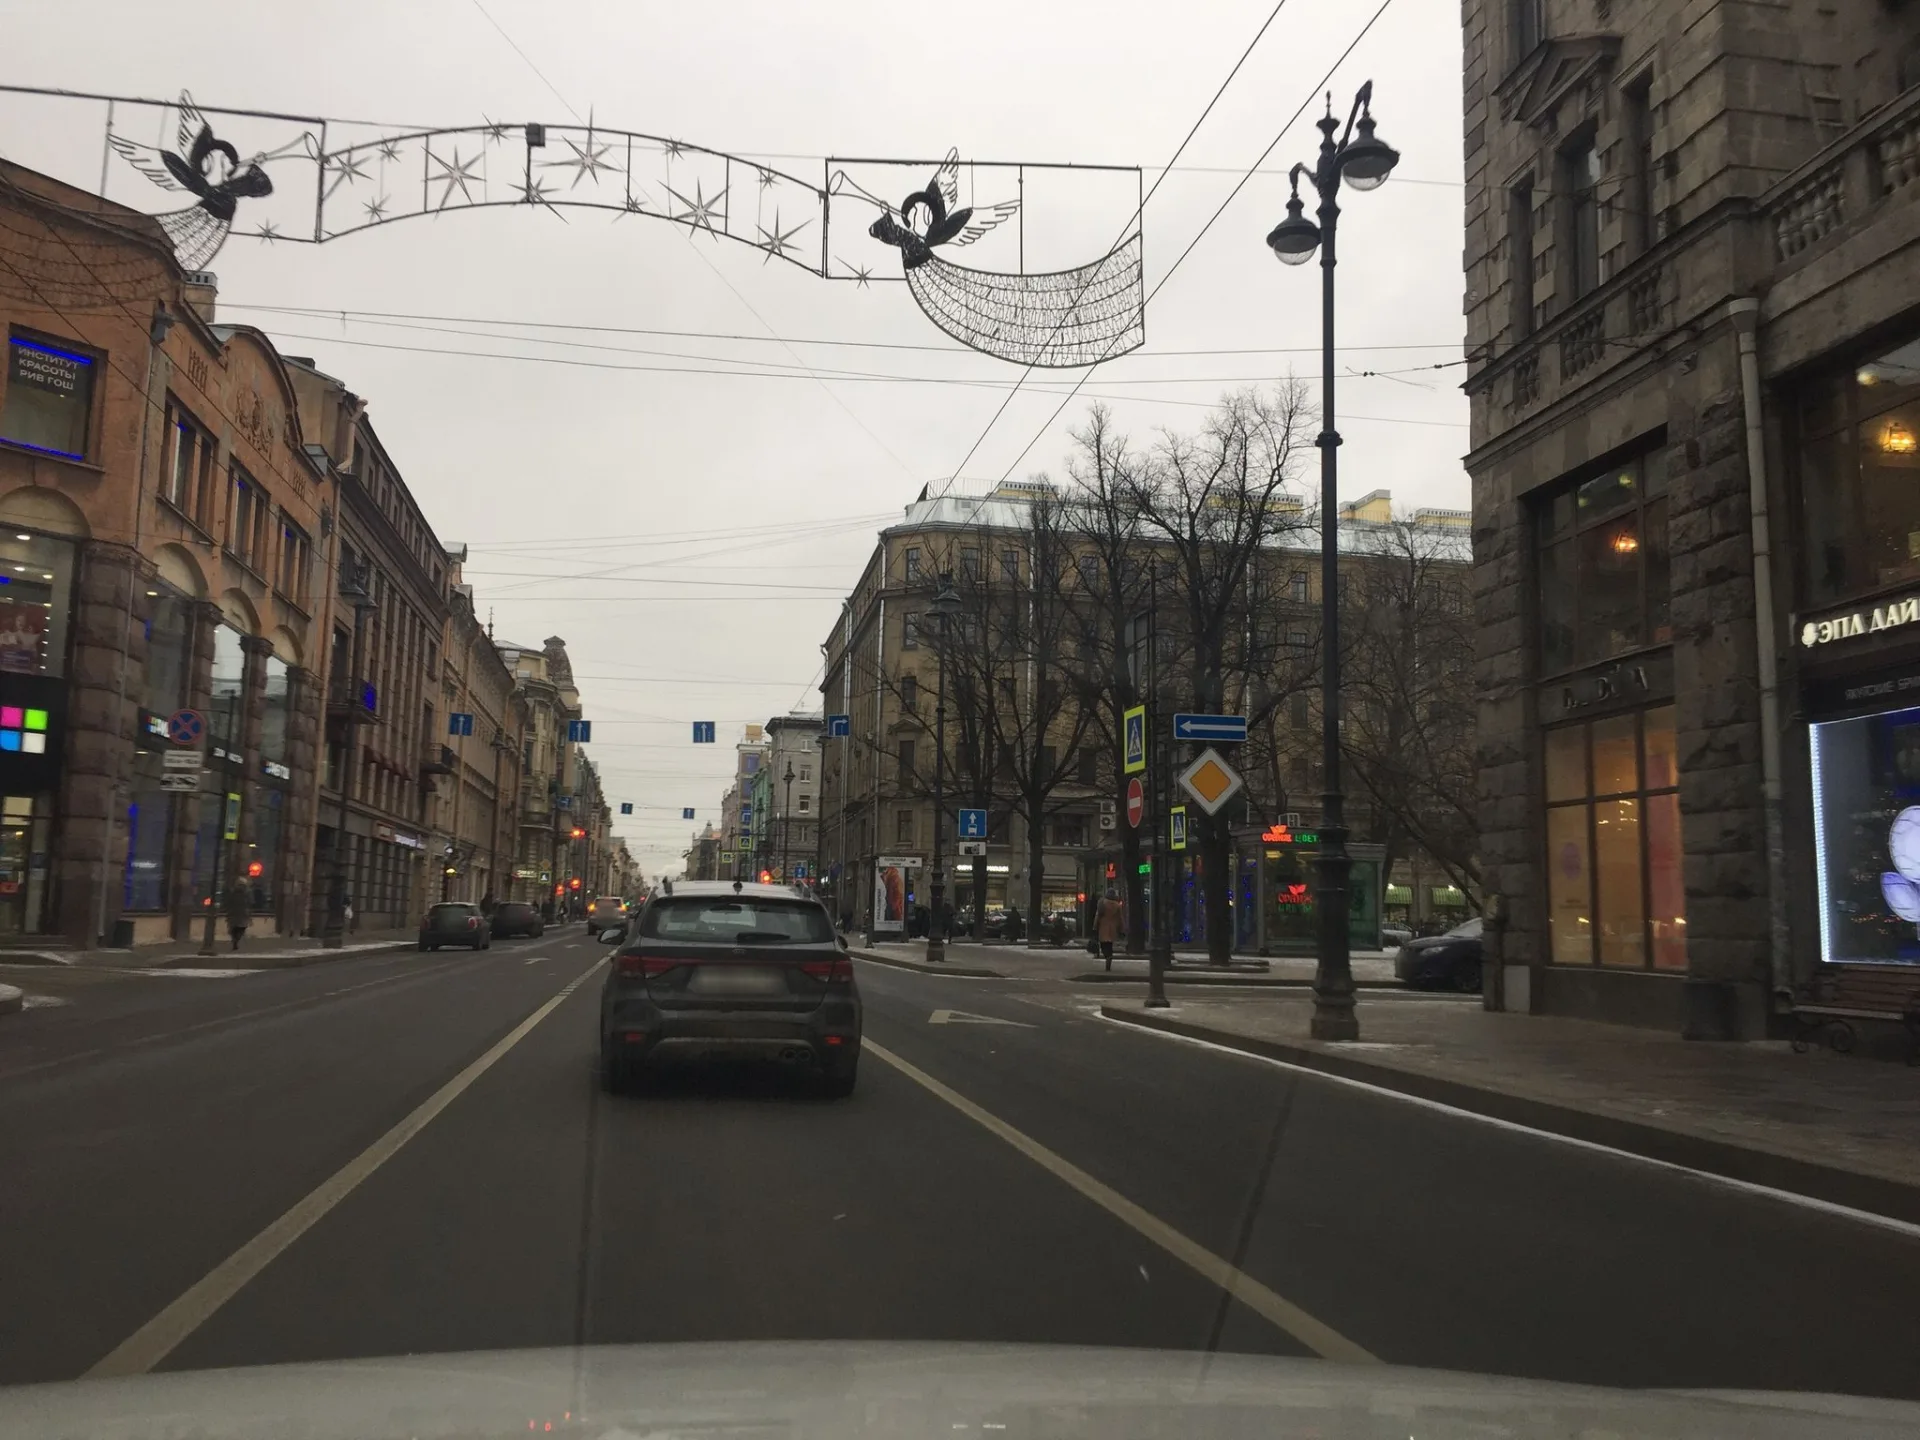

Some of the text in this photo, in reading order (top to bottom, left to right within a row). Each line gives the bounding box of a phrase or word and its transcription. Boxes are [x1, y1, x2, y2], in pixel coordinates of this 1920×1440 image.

[18, 347, 79, 370] ИНСТИТУТ
[18, 358, 76, 380] КРАСОТЫ
[19, 370, 74, 390] РИВ ГОШ
[1818, 597, 1920, 644] ЭПЛ ДАЙ
[1295, 834, 1318, 843] ЦВЕТ
